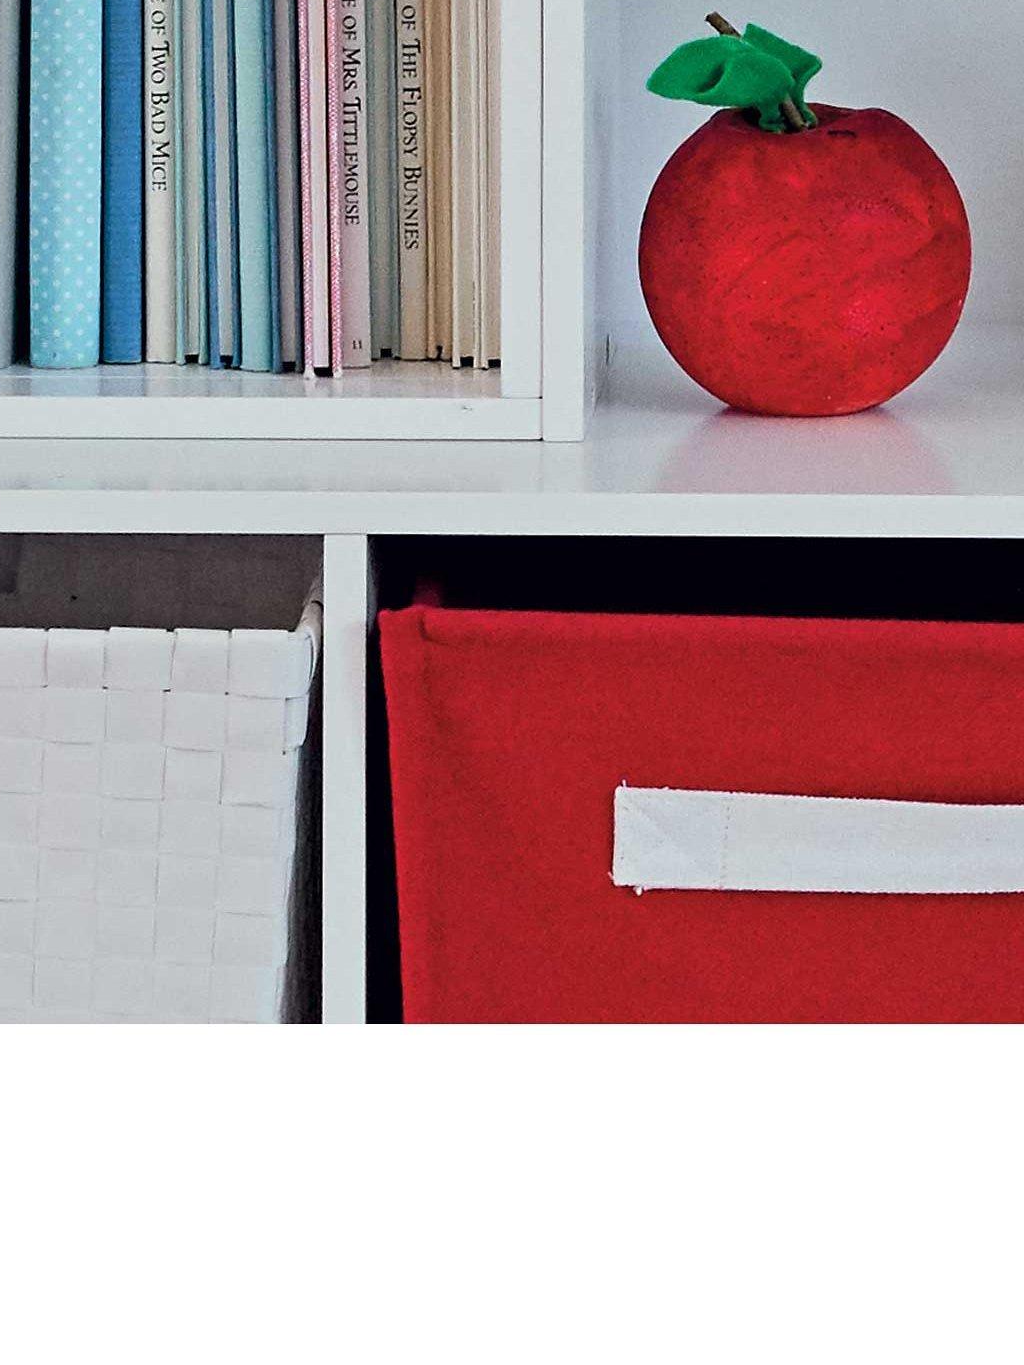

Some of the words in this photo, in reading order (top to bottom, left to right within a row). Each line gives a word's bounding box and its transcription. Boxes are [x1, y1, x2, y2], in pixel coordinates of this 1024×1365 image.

[151, 10, 166, 35] OF
[342, 15, 357, 41] OF
[401, 5, 417, 30] OF
[151, 40, 170, 83] TWO
[402, 38, 421, 78] THE
[151, 92, 170, 133] BAD
[402, 86, 421, 158] FLOPSY
[152, 140, 170, 192] MICE
[342, 97, 361, 226] TITTLEMOUSE
[403, 166, 422, 250] BUNNIES
